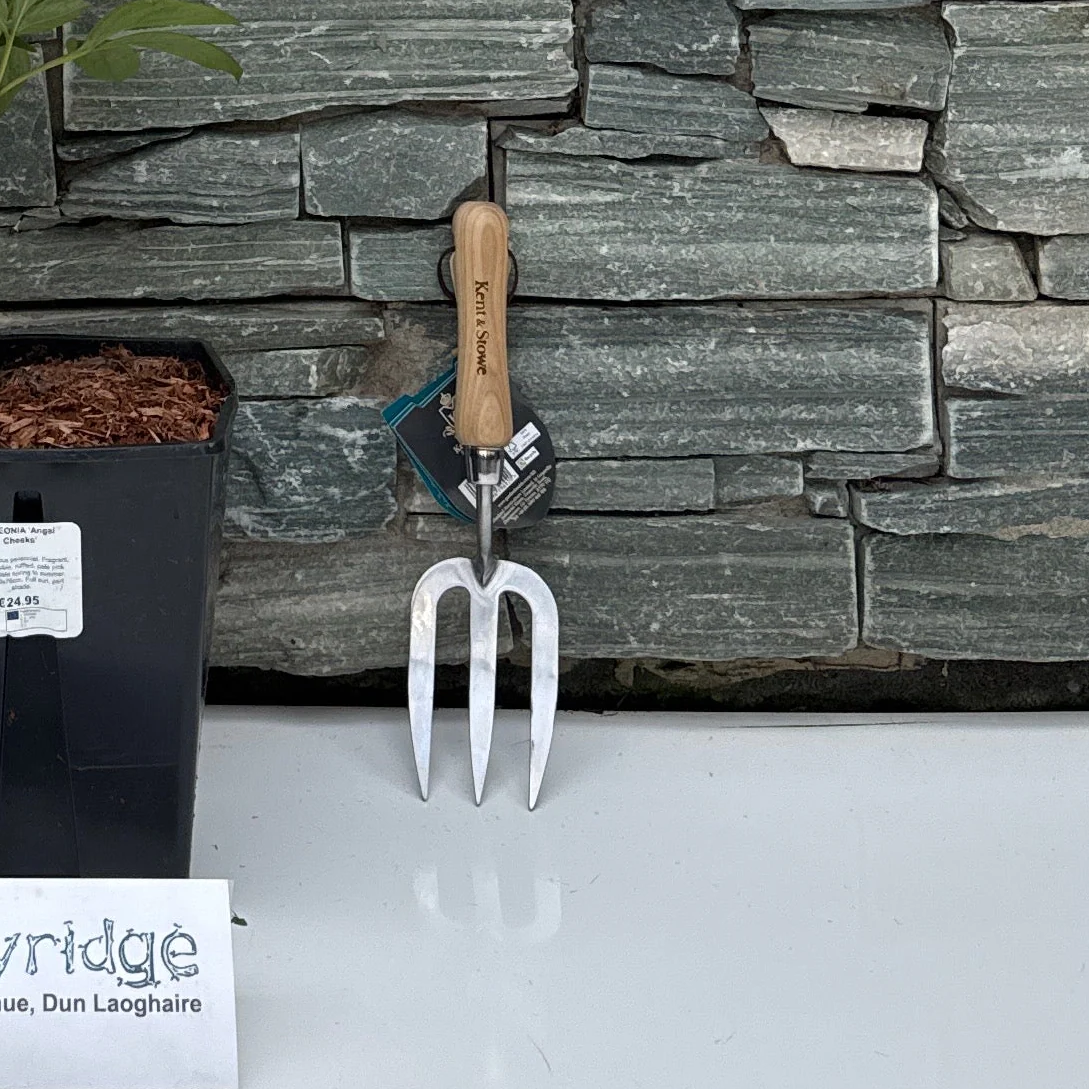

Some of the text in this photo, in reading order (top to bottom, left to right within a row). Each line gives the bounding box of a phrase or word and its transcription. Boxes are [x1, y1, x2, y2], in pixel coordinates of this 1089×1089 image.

[475, 280, 490, 376] Kent & Stowe
[42, 993, 86, 1013] Dun
[94, 992, 202, 1017] Laoghaire
